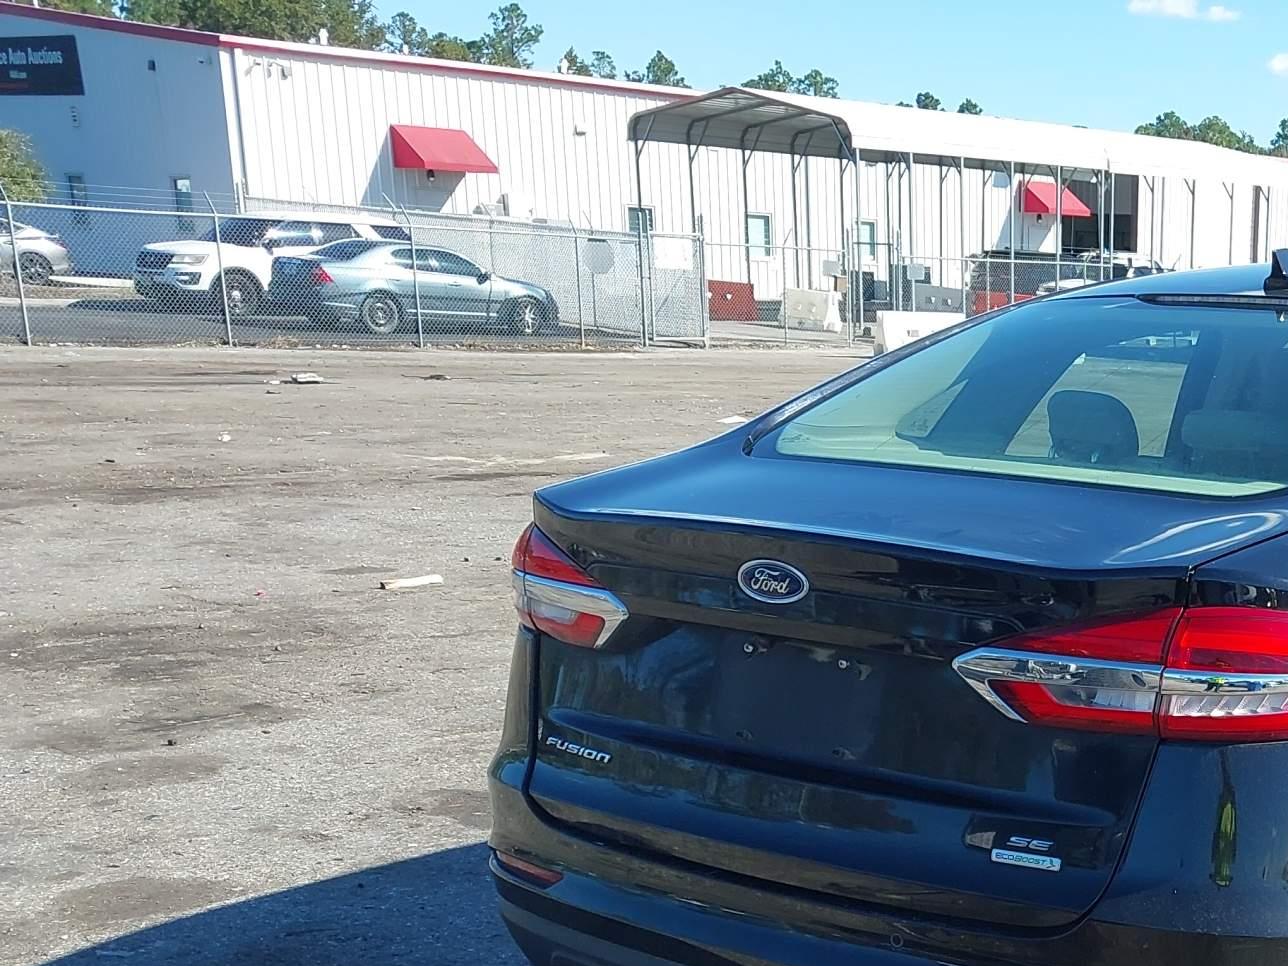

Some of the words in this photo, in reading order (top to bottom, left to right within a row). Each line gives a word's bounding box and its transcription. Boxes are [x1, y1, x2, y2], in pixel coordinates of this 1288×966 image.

[8, 47, 27, 65] Auto
[27, 46, 64, 65] Auctions
[751, 567, 791, 594] Ford
[545, 736, 612, 764] FUSION
[1006, 836, 1054, 851] SE
